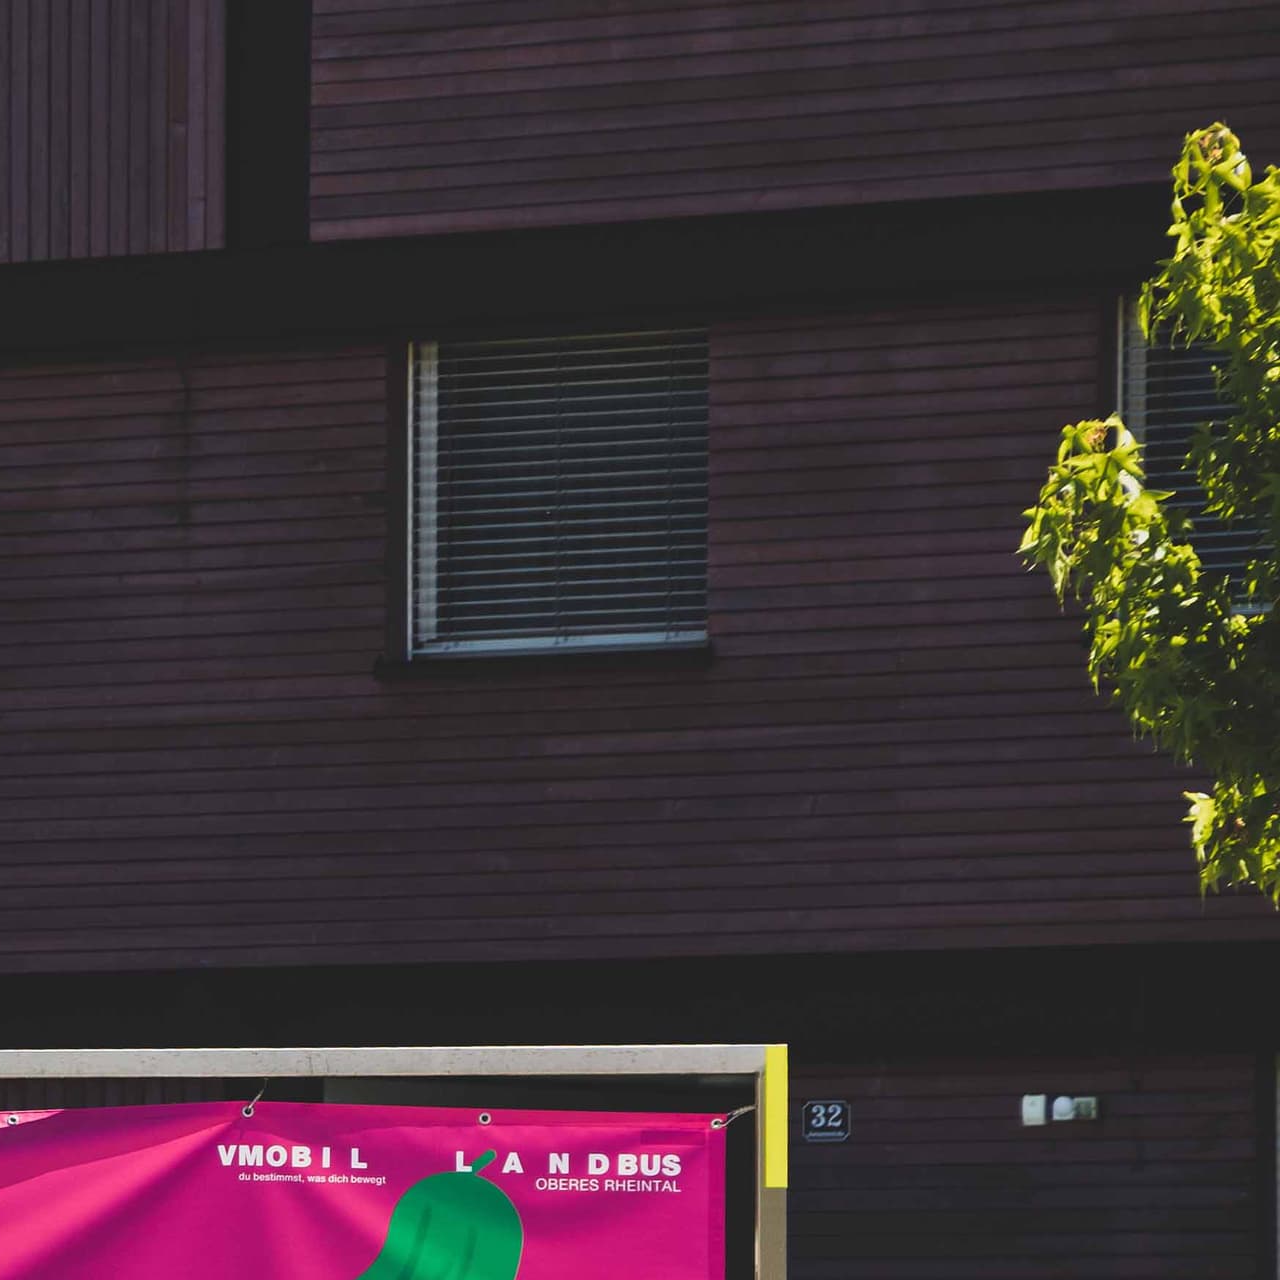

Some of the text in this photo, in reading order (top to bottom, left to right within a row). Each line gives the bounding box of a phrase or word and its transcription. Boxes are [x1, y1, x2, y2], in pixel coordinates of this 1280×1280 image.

[811, 1104, 843, 1128] 32
[238, 1172, 386, 1187] du bestimmst, was dich bewegt
[535, 1177, 682, 1193] OBERES RHEINTAL
